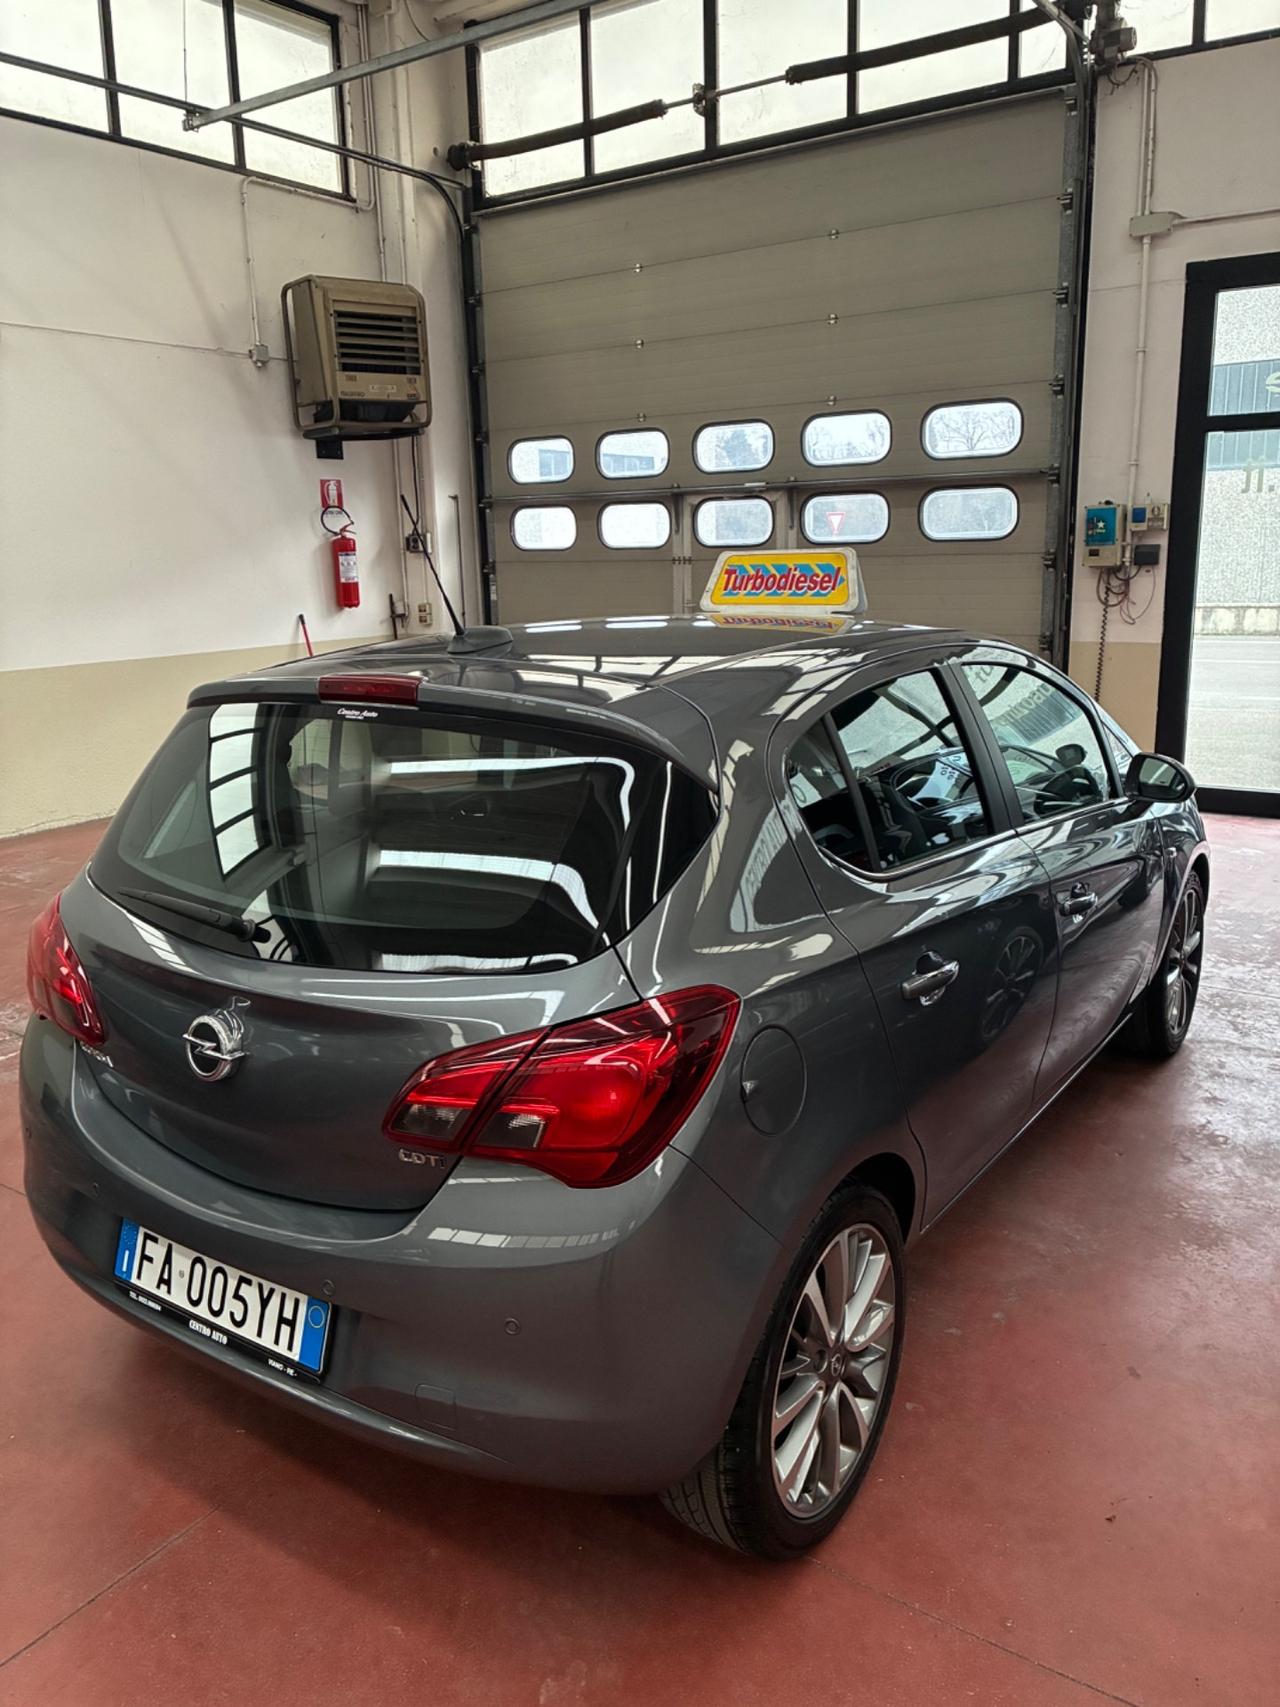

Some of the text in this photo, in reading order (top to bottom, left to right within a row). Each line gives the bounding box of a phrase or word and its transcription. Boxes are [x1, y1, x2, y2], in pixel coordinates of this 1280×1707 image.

[723, 566, 842, 592] Turbodiesel
[137, 1231, 300, 1352] FA 005YH
[189, 1319, 228, 1345] CENTRO AUTO
